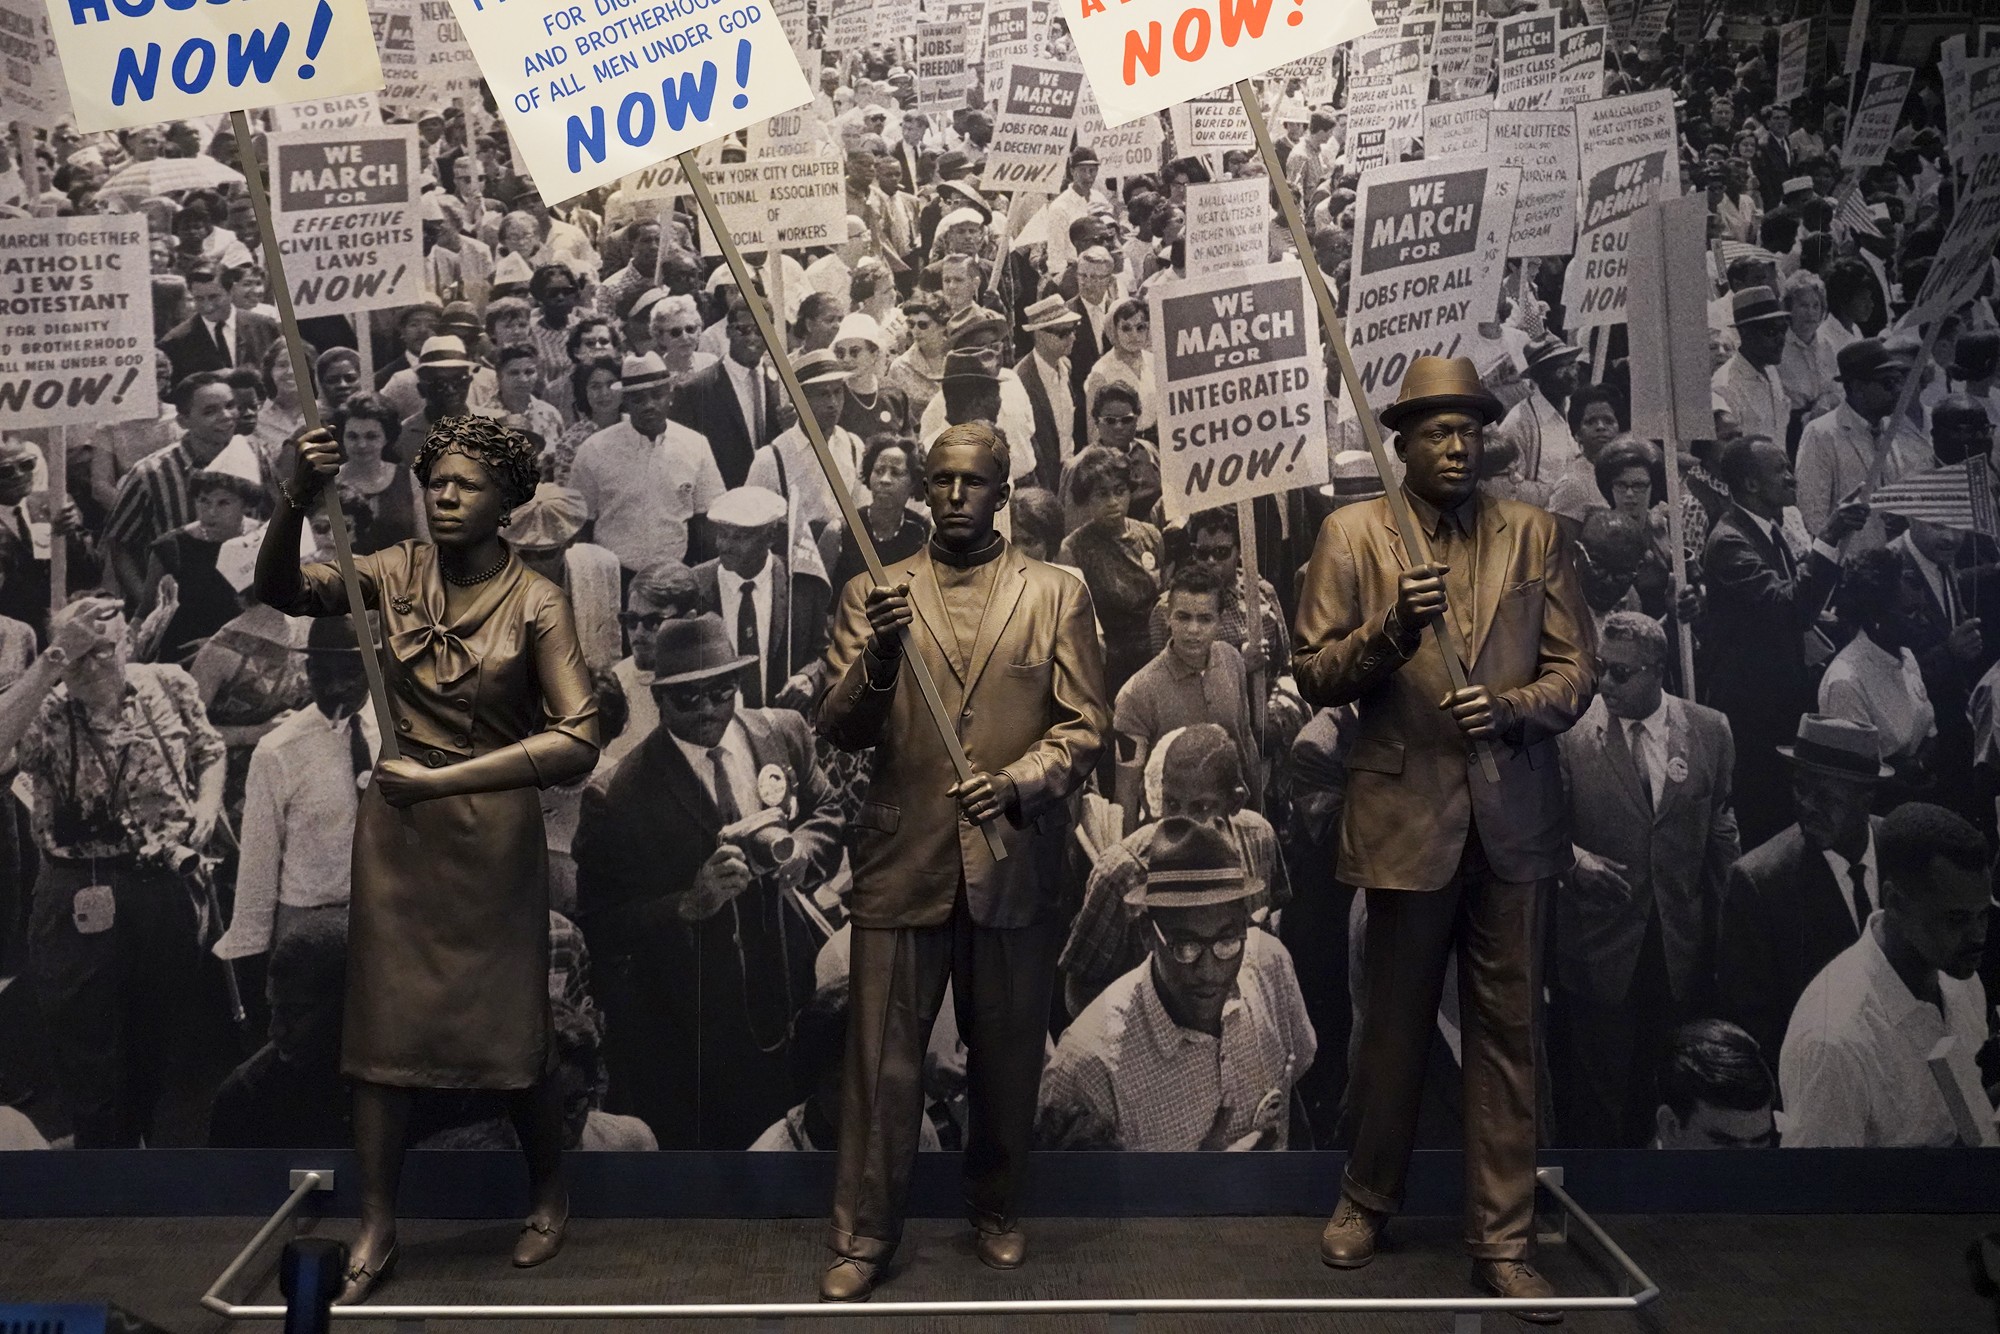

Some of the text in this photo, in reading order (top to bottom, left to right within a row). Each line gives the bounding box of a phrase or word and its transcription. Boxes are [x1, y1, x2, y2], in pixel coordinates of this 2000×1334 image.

[543, 6, 586, 37] FOR
[998, 11, 1011, 21] WE
[1443, 11, 1471, 22] MARCH
[989, 20, 1025, 36] MARCH
[1518, 21, 1535, 34] WE
[524, 0, 721, 77] AND BROTHERHO
[920, 40, 952, 57] JOBS
[1506, 31, 1551, 52] MARCH
[1567, 32, 1587, 52] WE
[112, 0, 334, 107] NOW!
[515, 88, 542, 114] OF
[550, 73, 586, 102] ALL
[593, 51, 639, 84] MEN
[643, 23, 713, 64] UNDER
[718, 5, 762, 34] GOD
[1380, 44, 1402, 62] WE
[1517, 48, 1536, 57] FOR
[920, 58, 965, 79] FREEDOM
[1265, 66, 1324, 78] SCHOOLS
[1442, 58, 1470, 73] NOW!
[1503, 64, 1524, 79] FIRST
[1526, 58, 1556, 73] CLASS
[1038, 72, 1060, 86] WE
[1501, 72, 1557, 95] CITIZENSHIP
[323, 96, 370, 115] BIAS
[567, 38, 752, 174] NOW!
[1013, 85, 1074, 106] MARCH
[1508, 89, 1553, 111] NOW!
[1028, 106, 1053, 115] FOR
[1228, 105, 1243, 116] BE
[1592, 100, 1660, 121] AMALGAMATED
[767, 115, 802, 138] GUILD
[999, 122, 1068, 138] JOBS FOR ALL
[1194, 118, 1248, 129] BURIED IN
[1430, 114, 1452, 129] MEAT
[1495, 124, 1571, 139] MEAT CUTTERS
[1589, 115, 1655, 137] MEAT CUTTERS
[1091, 131, 1143, 148] PEOPLE
[1195, 130, 1249, 141] OUR GRAVE
[1653, 128, 1671, 141] MEN
[323, 144, 363, 165] WE
[993, 141, 1065, 156] A DECENT PAY
[1125, 147, 1153, 165] GOD
[290, 163, 399, 194] MARCH
[729, 167, 759, 184] YORK
[763, 165, 789, 181] CITY
[791, 161, 840, 179] CHAPTER
[992, 162, 1057, 183] NOW!
[1614, 160, 1647, 191] WE
[324, 191, 368, 205] FOR
[770, 182, 840, 202] ASSOCIATION
[1408, 180, 1447, 207] WE
[293, 211, 404, 234] EFFECTIVE
[767, 208, 781, 223] OF
[1370, 203, 1474, 249] MARCH
[57, 231, 141, 248] TOGETHER
[279, 228, 413, 256] CIVIL RIGHTS
[777, 224, 828, 242] WORKERS
[316, 251, 377, 272] LAWS
[1399, 241, 1441, 261] FOR
[0, 253, 122, 275] ATHOLIC
[13, 274, 94, 295] JEWS
[294, 263, 406, 307] NOW!
[1355, 266, 1473, 314] JOBS FOR ALL
[1211, 290, 1255, 318] WE
[6, 320, 110, 338] FOR DIGNITY
[1176, 309, 1295, 357] MARCH
[1351, 300, 1471, 348] A DECENT PAY
[21, 337, 138, 355] BROTHERHOOD
[26, 358, 55, 372] MEN
[62, 356, 108, 371] UNDER
[115, 353, 144, 368] GOD
[1214, 347, 1261, 368] FOR
[0, 366, 140, 413] NOW!
[1168, 366, 1310, 416] INTEGRATED
[1171, 402, 1311, 452] SCHOOLS
[1185, 433, 1307, 497] NOW!
